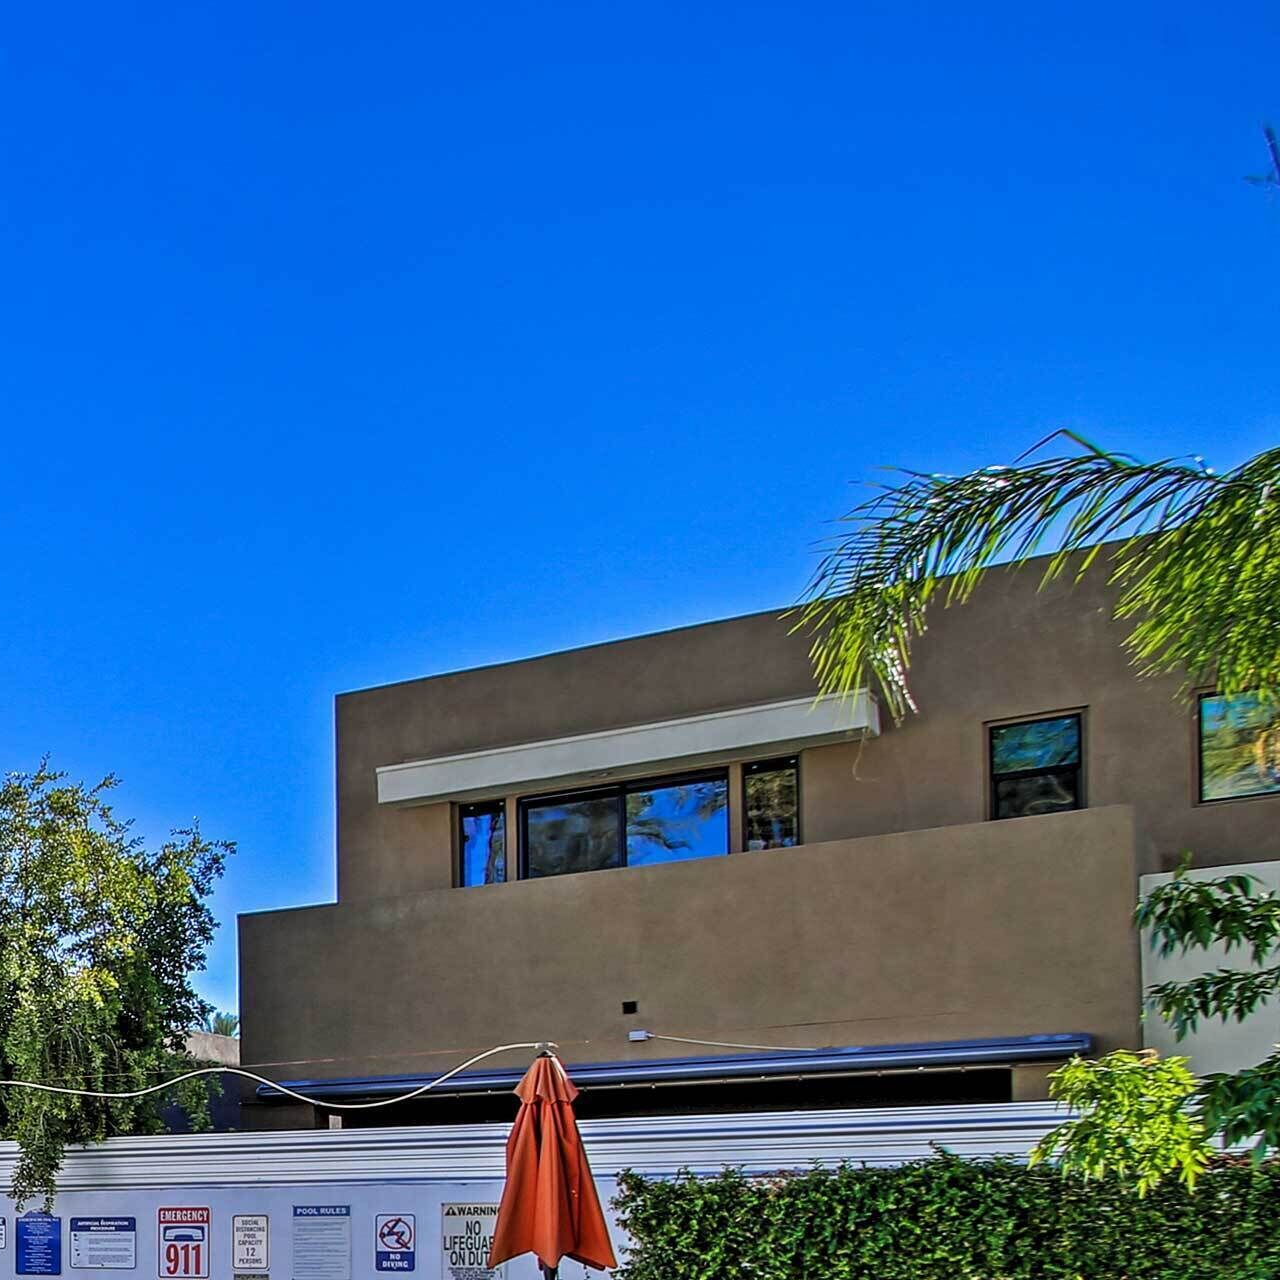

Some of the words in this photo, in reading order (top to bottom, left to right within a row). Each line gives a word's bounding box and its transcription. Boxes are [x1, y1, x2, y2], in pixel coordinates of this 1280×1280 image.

[160, 1209, 208, 1221] EMERGENCY
[296, 1207, 318, 1215] POOL
[456, 1206, 500, 1216] WARNIN
[465, 1220, 482, 1236] NO
[443, 1236, 495, 1251] LIFEGUA
[245, 1247, 256, 1257] 12
[389, 1253, 401, 1261] NO
[165, 1243, 201, 1275] 911
[450, 1251, 466, 1266] ON
[468, 1250, 491, 1266] DUT
[382, 1260, 409, 1268] DIVING
